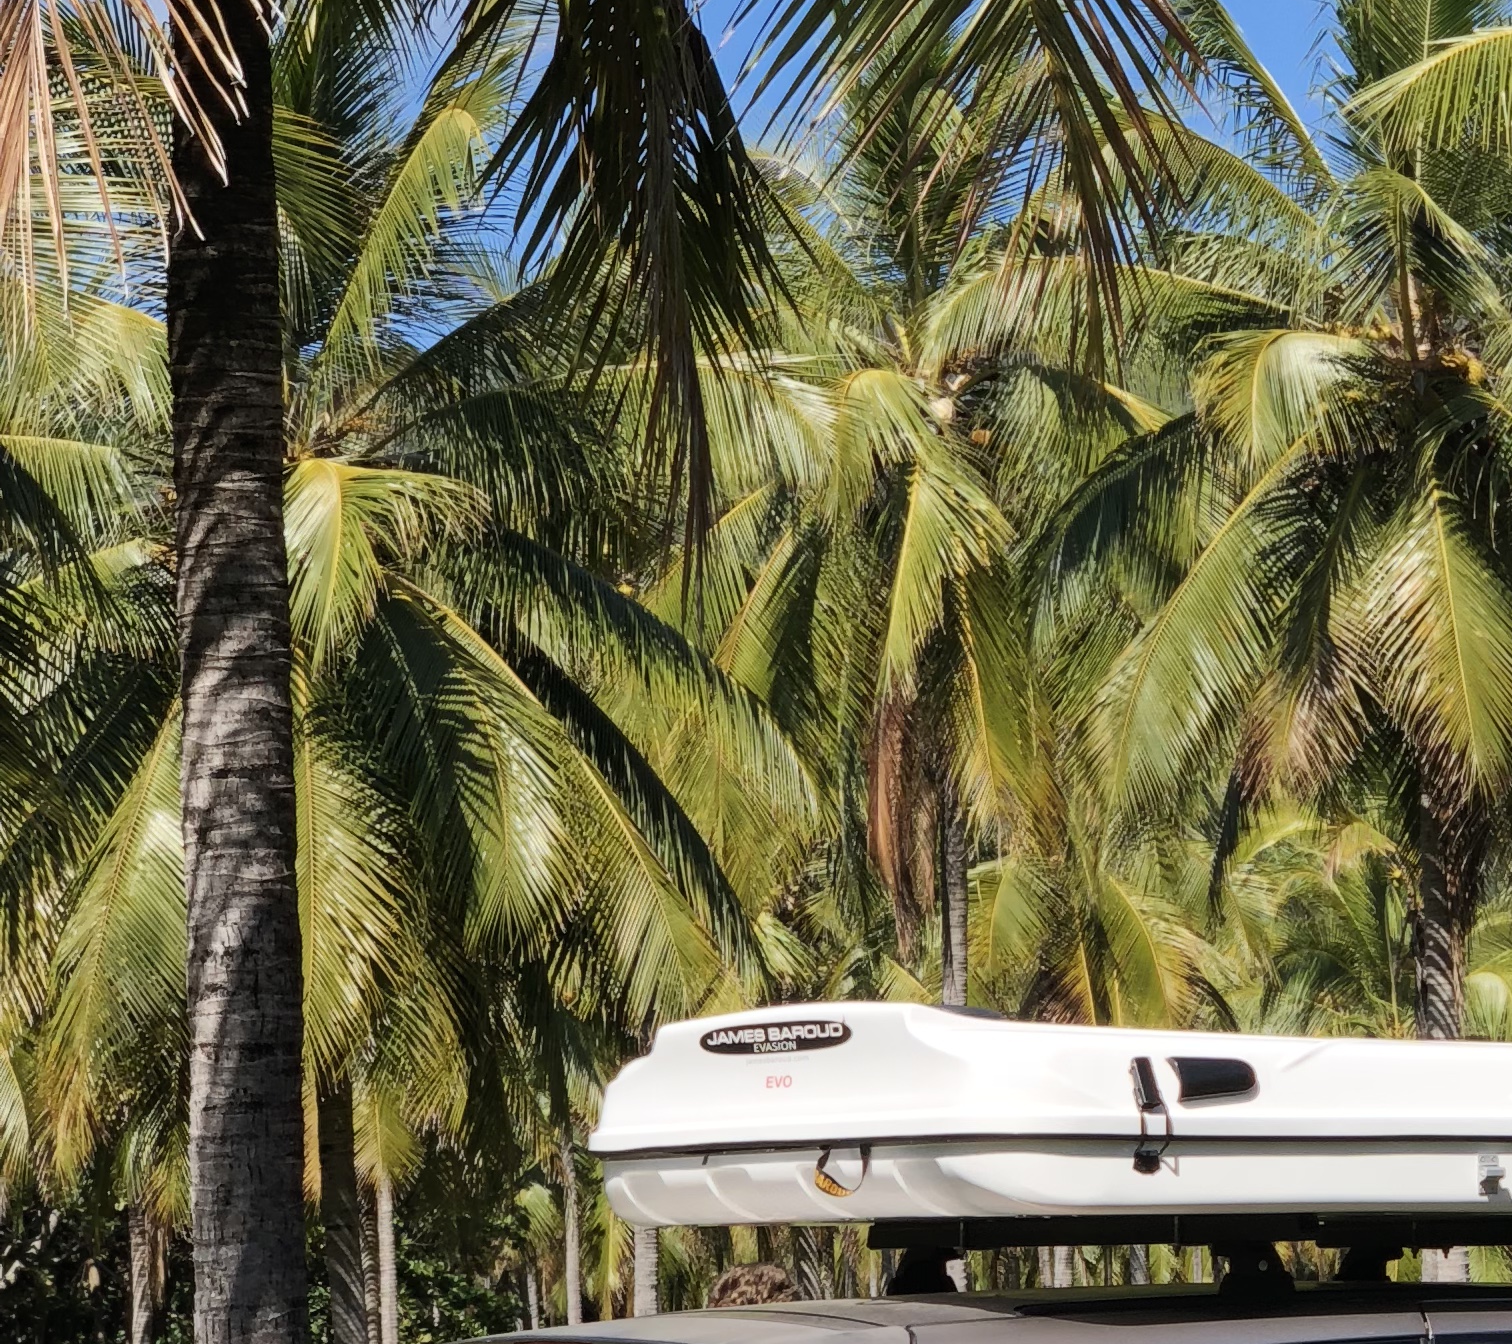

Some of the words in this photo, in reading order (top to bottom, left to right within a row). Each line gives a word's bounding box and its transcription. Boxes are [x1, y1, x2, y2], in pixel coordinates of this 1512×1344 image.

[707, 1027, 765, 1046] JAMES
[768, 1023, 843, 1042] BAROUD
[753, 1040, 797, 1053] EVASION
[765, 1075, 793, 1088] EVO
